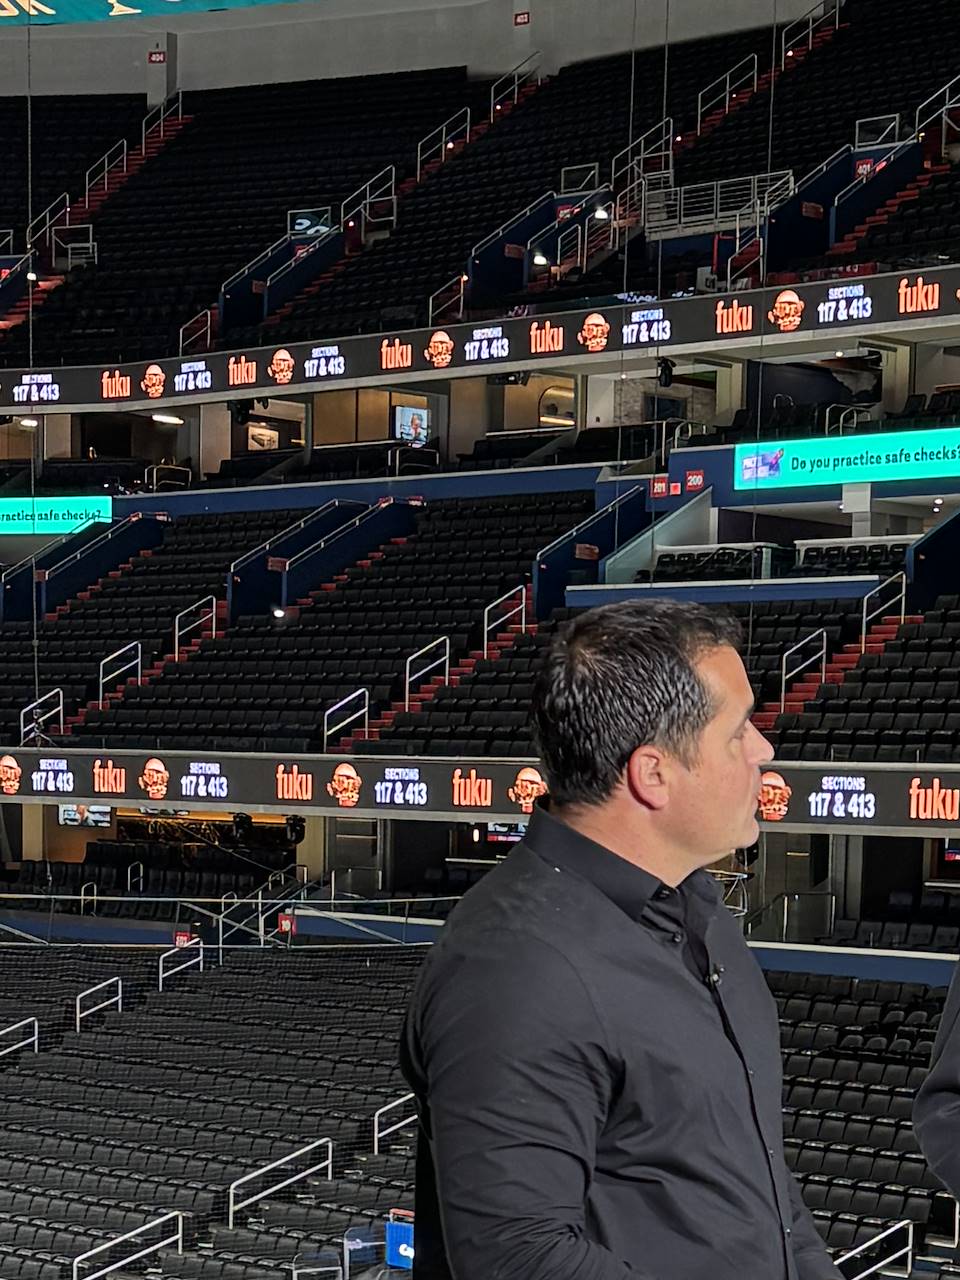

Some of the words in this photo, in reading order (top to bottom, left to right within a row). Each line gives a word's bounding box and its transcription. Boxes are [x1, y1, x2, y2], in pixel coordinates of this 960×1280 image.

[899, 277, 940, 314] fuku
[716, 300, 753, 334] fuku
[530, 321, 564, 354] fuku
[382, 339, 412, 370] fuku
[102, 370, 131, 399] fuku
[229, 356, 257, 386] fuku
[791, 456, 808, 470] Do
[809, 457, 830, 473] you
[833, 450, 882, 471] practice
[884, 448, 911, 465] safe
[0, 510, 36, 521] ractice
[93, 760, 126, 793] fuku
[277, 765, 313, 800] fuku
[453, 769, 492, 807] fuku
[822, 776, 866, 791] SECTIONS
[808, 792, 832, 817] 117
[832, 791, 846, 818] &
[847, 793, 876, 819] 413
[910, 778, 960, 821] fuku
